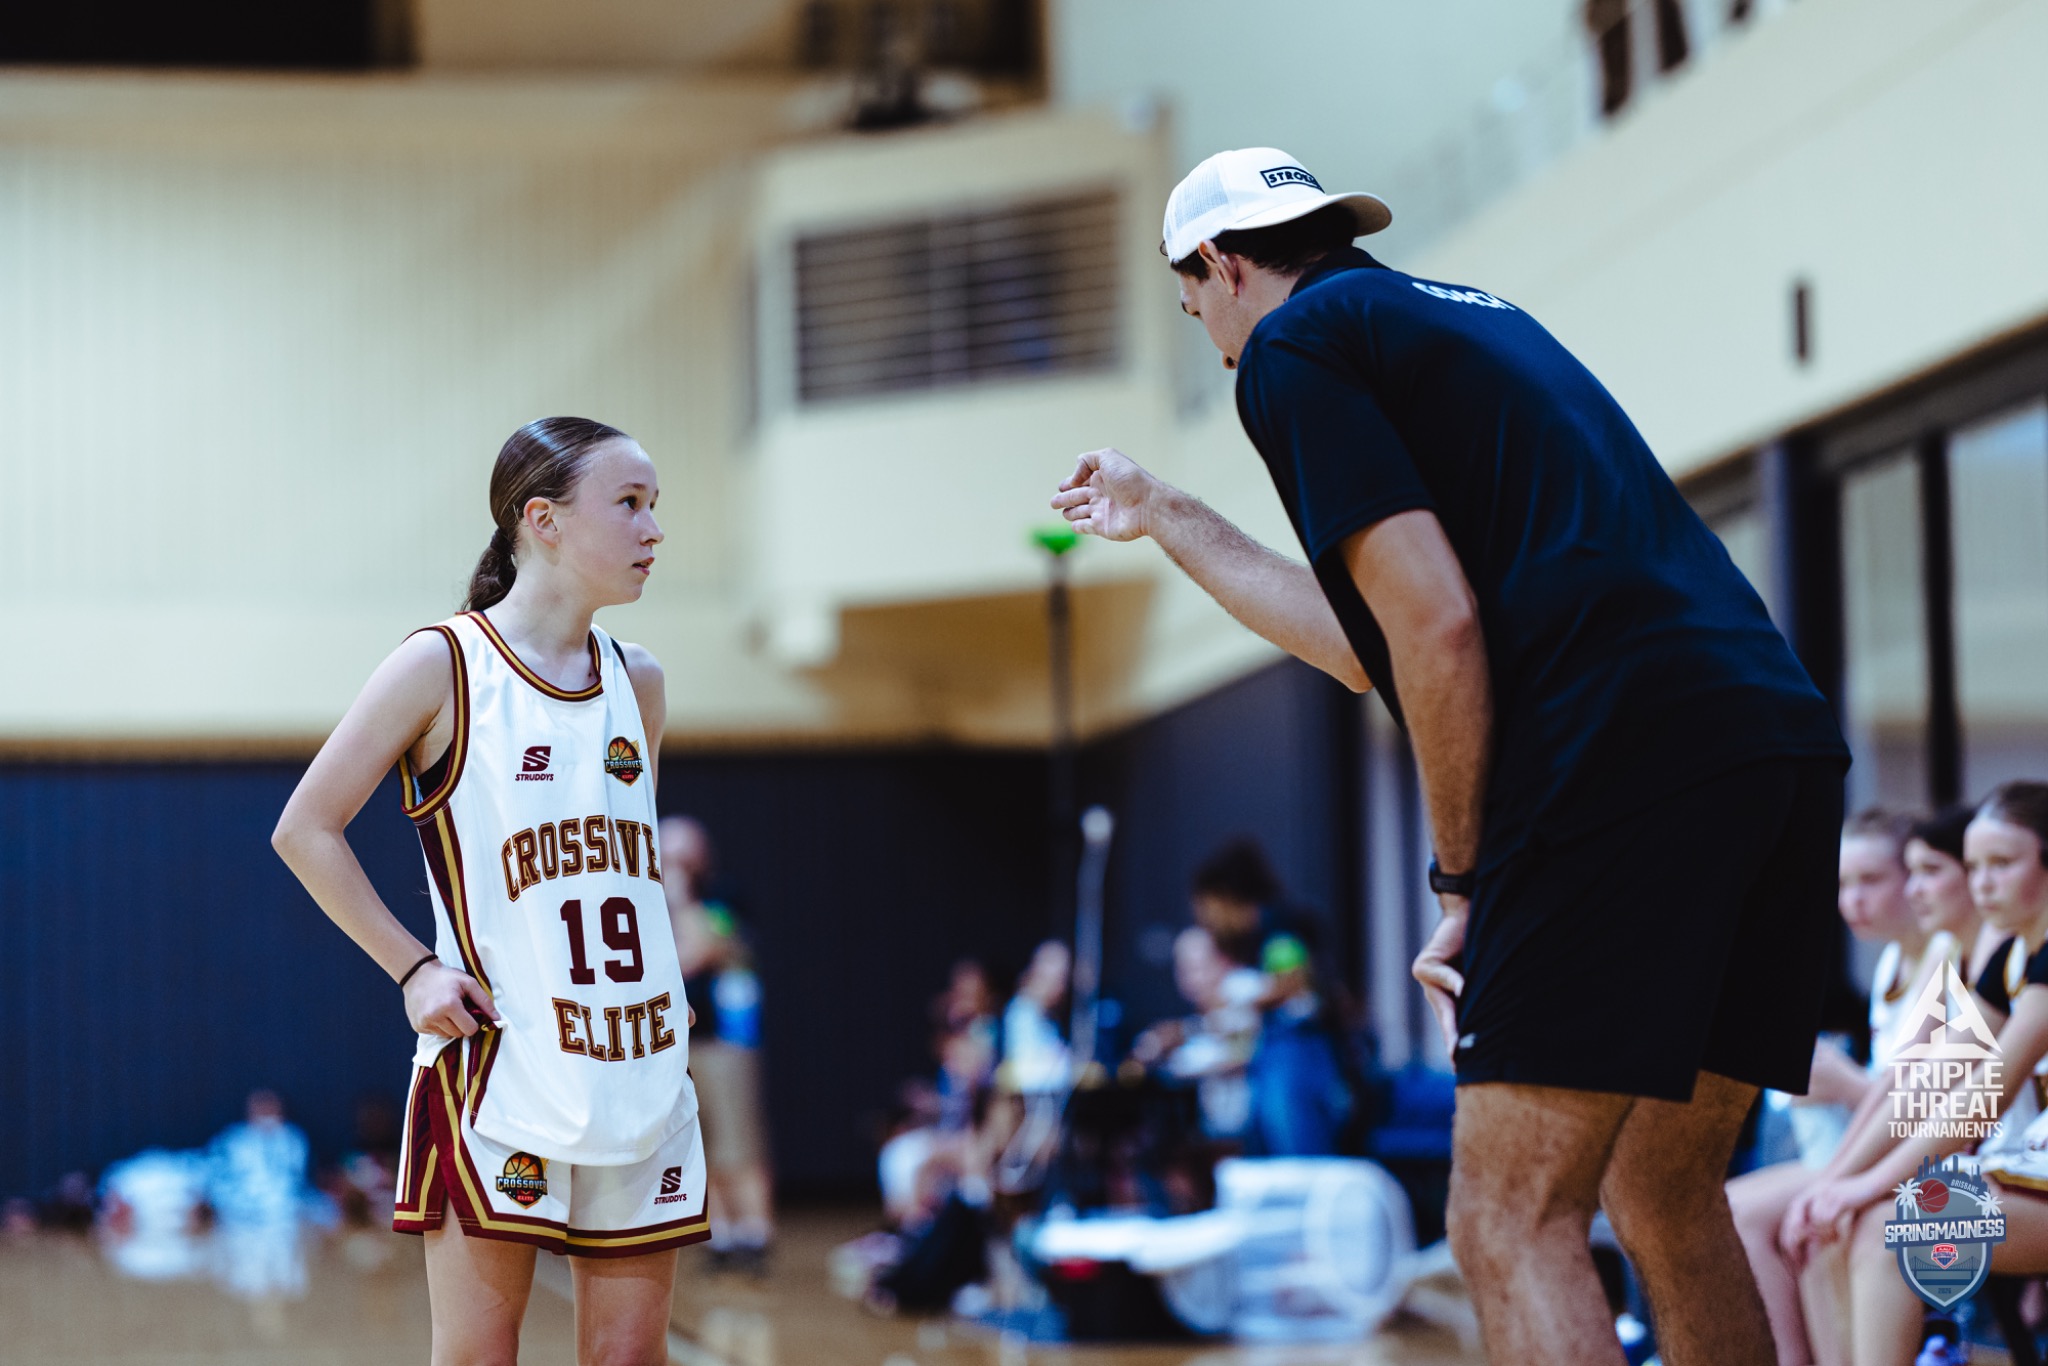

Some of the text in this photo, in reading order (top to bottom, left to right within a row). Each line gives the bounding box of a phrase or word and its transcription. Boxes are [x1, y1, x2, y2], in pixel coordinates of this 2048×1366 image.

[515, 773, 554, 782] STRUDDYS
[501, 815, 662, 901] CROSSOVE
[560, 897, 645, 985] 19
[551, 991, 676, 1062] ELITE
[497, 1178, 547, 1191] CROSSOVER
[654, 1193, 687, 1205] STRUDDYS
